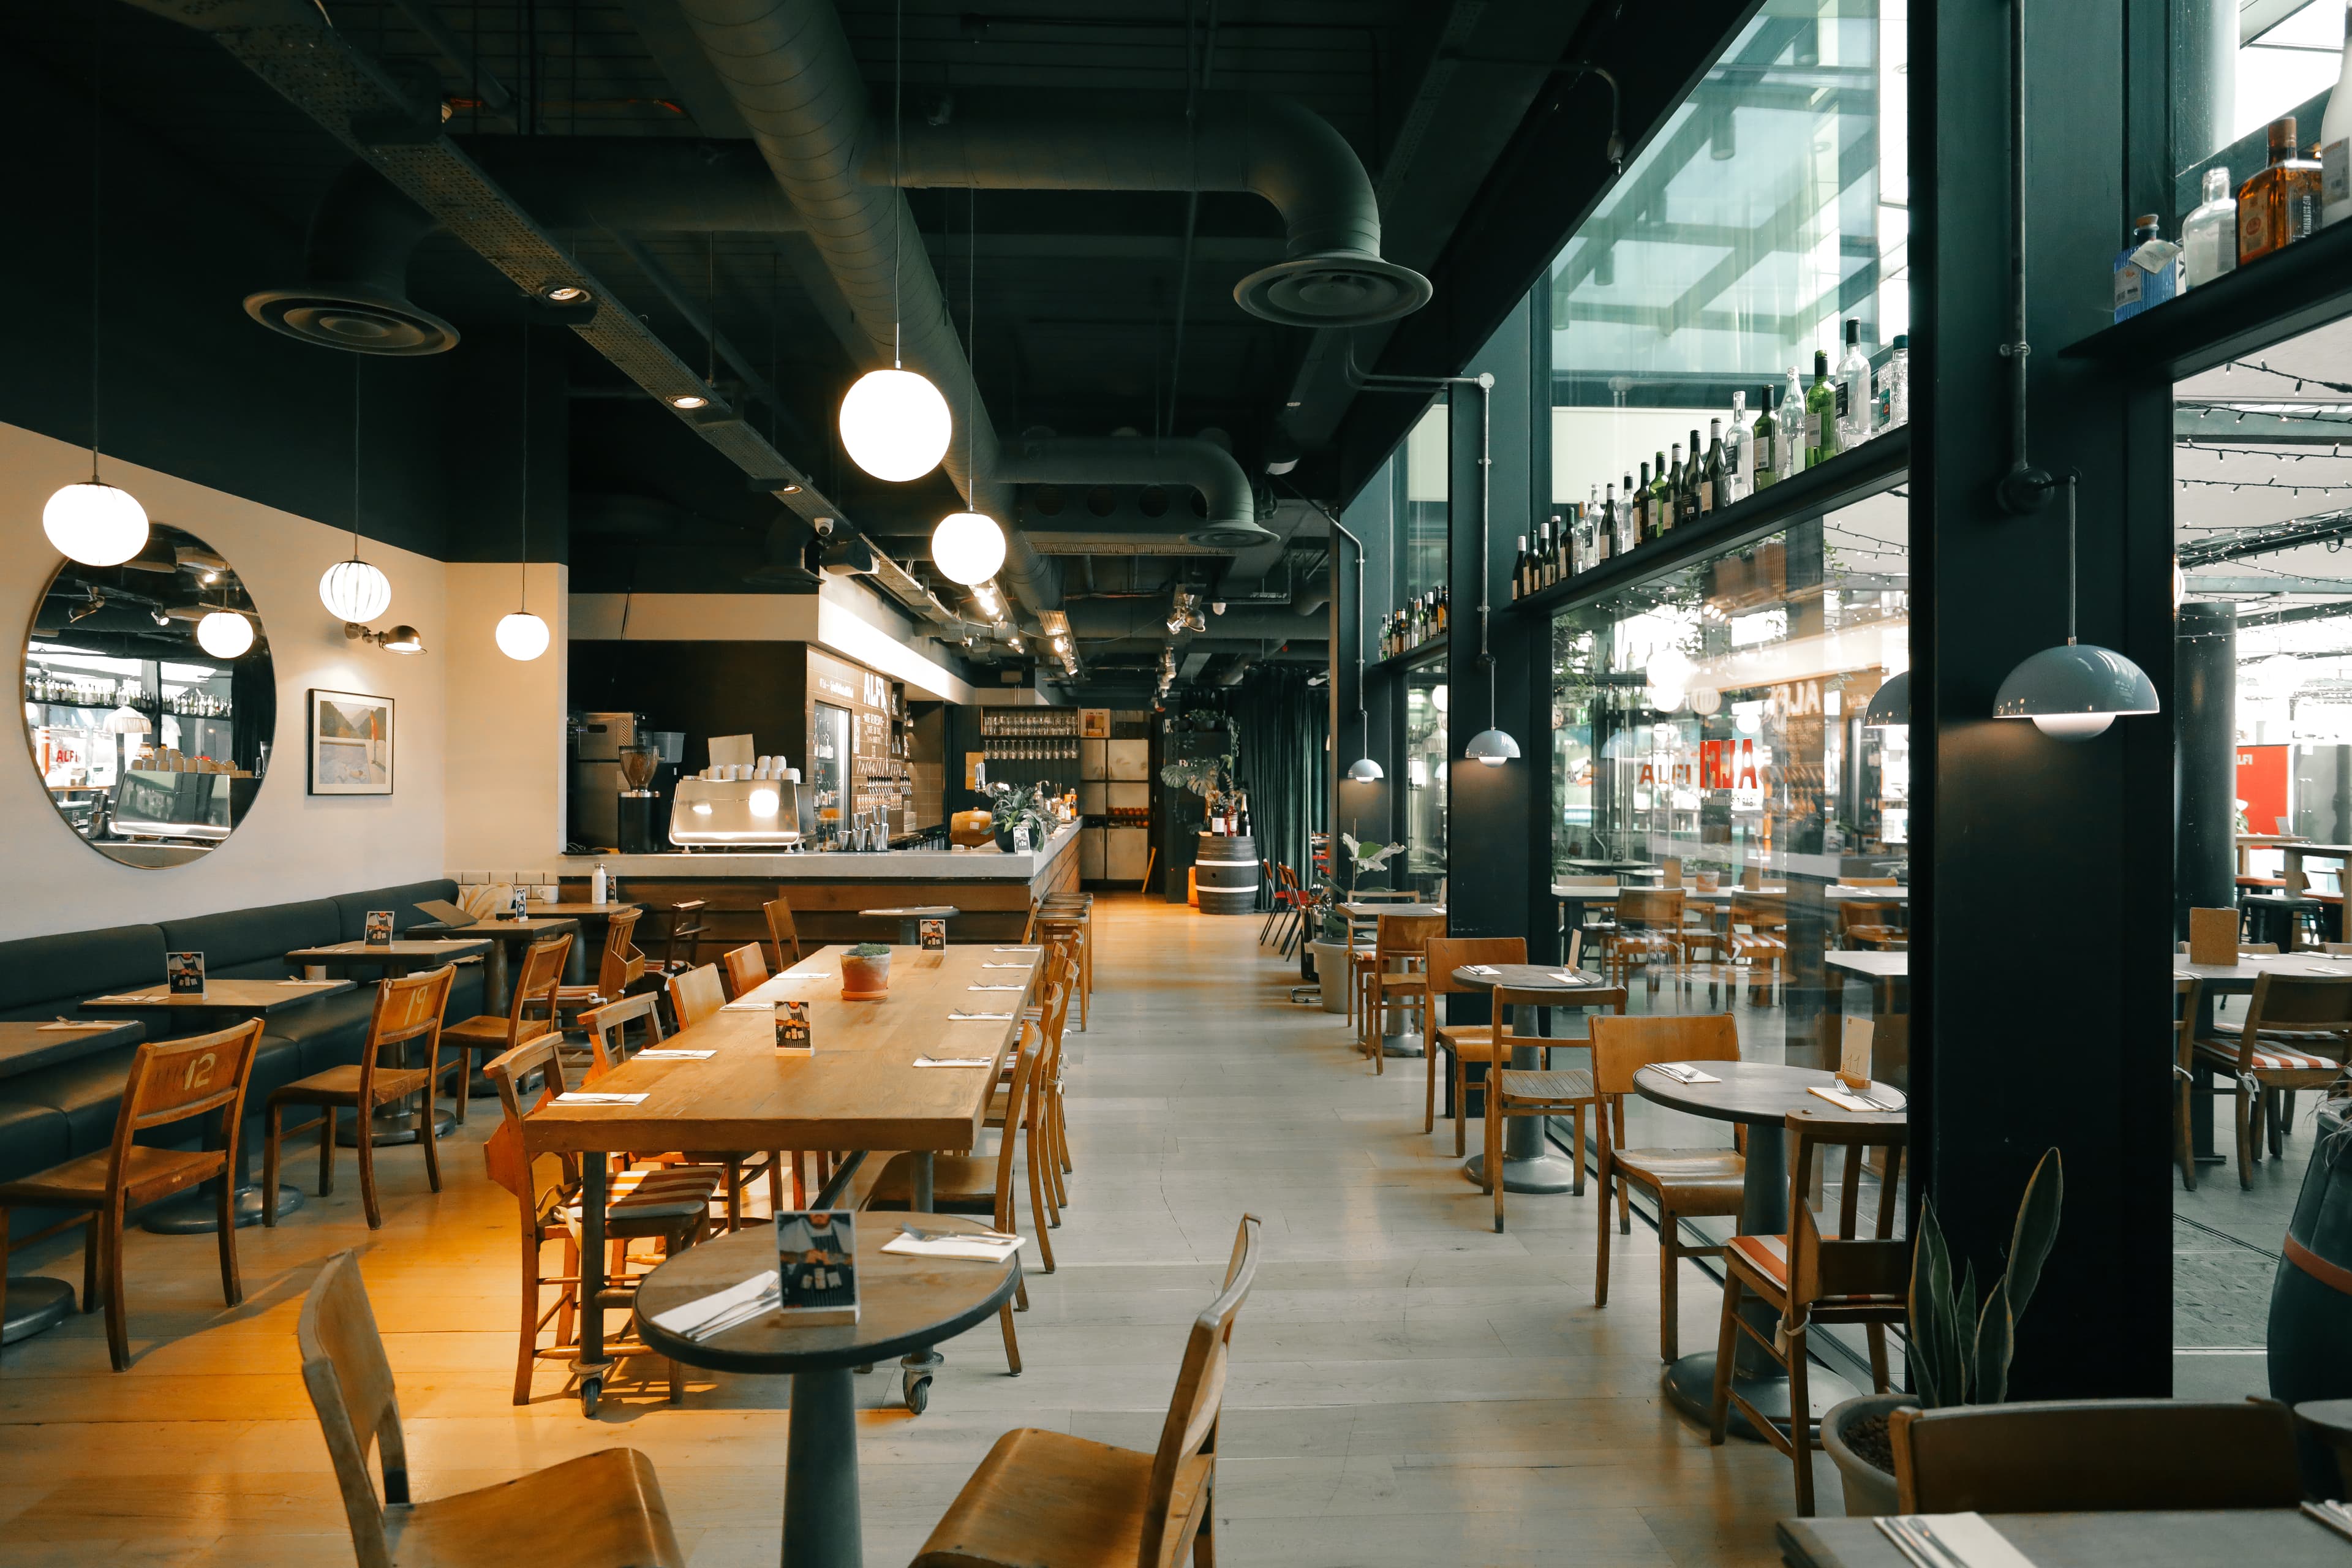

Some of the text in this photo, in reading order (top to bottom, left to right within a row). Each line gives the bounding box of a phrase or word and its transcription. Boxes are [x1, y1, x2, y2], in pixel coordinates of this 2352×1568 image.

[864, 672, 888, 709] ALFI
[1639, 764, 1691, 785] ALFI
[2236, 754, 2253, 765] LFI
[404, 985, 428, 1025] 19
[184, 1053, 216, 1090] 12
